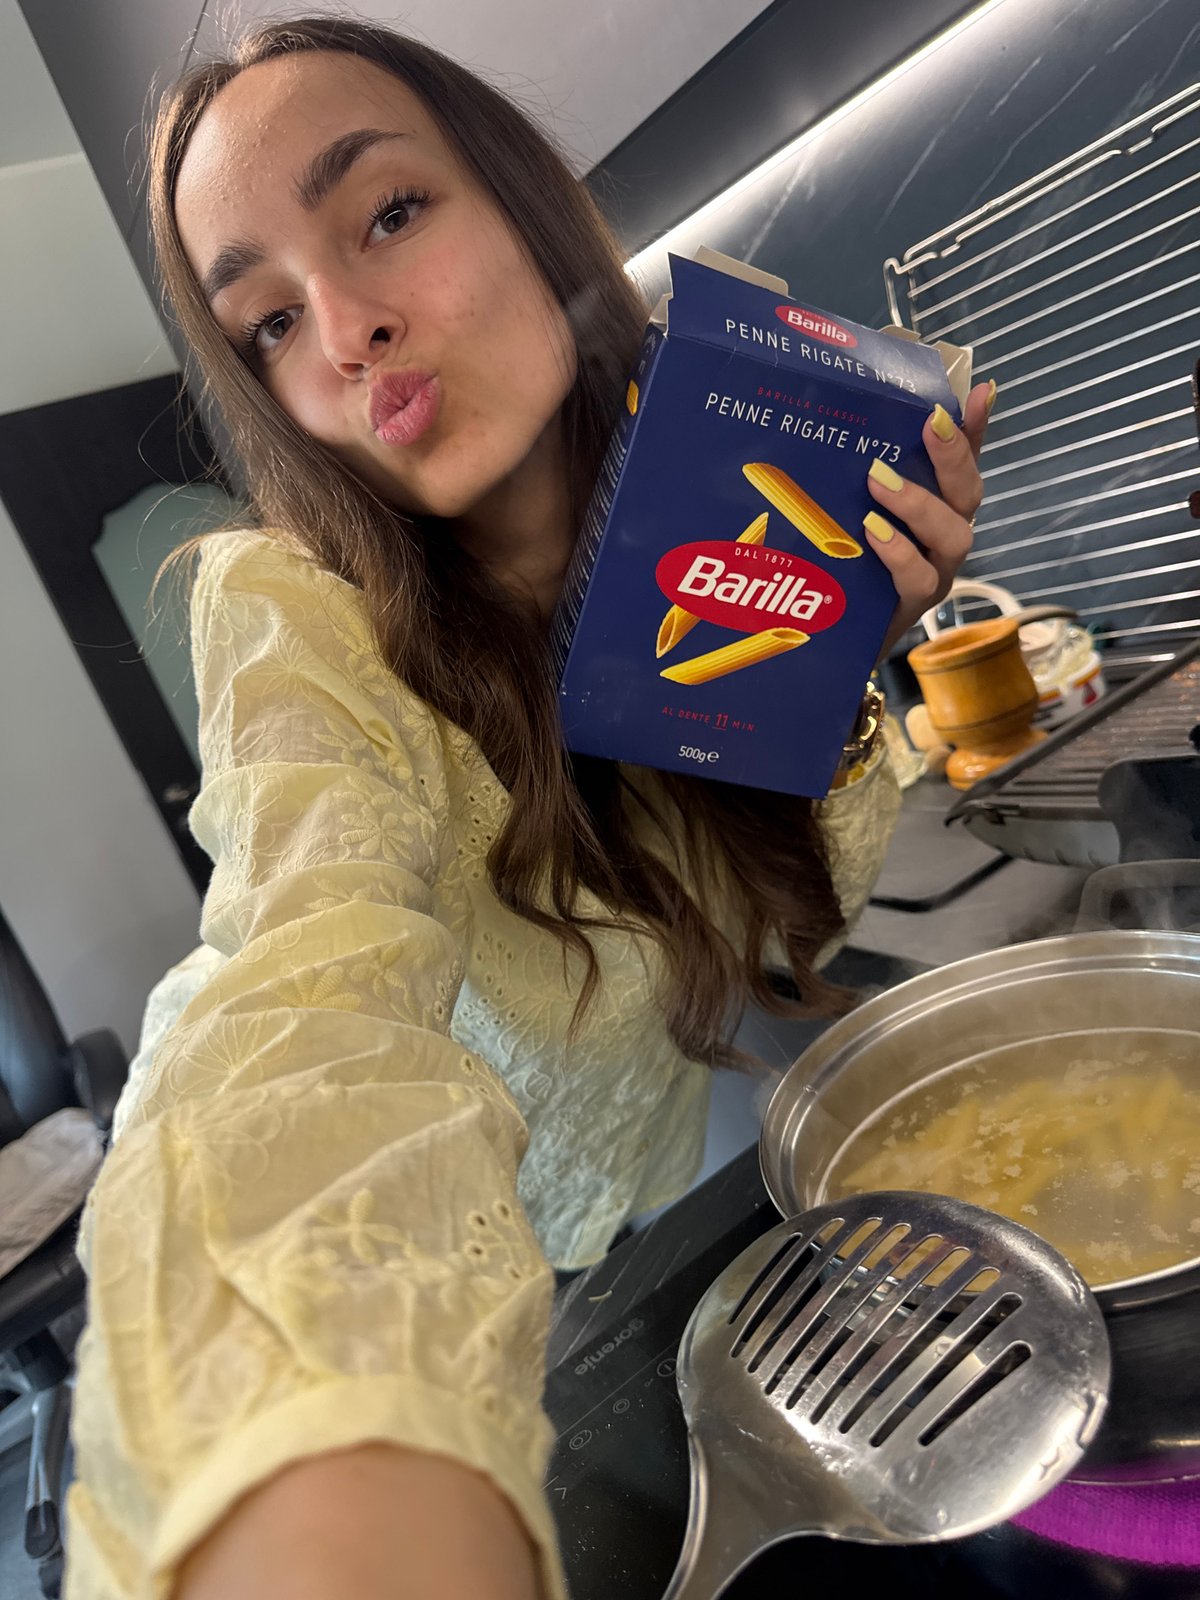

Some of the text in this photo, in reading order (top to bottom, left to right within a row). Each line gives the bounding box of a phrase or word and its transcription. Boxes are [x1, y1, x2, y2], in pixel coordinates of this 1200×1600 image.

[787, 310, 849, 343] Barilla
[725, 319, 791, 353] PENNE
[801, 343, 866, 377] RIGATE
[757, 386, 868, 426] BARILLA CLASSIC
[705, 392, 901, 463] PENNE RIGATE N°73
[735, 547, 793, 568] DAL 1877
[662, 706, 673, 717] AL
[678, 709, 711, 724] DENTE
[574, 1317, 645, 1376] gorenje
